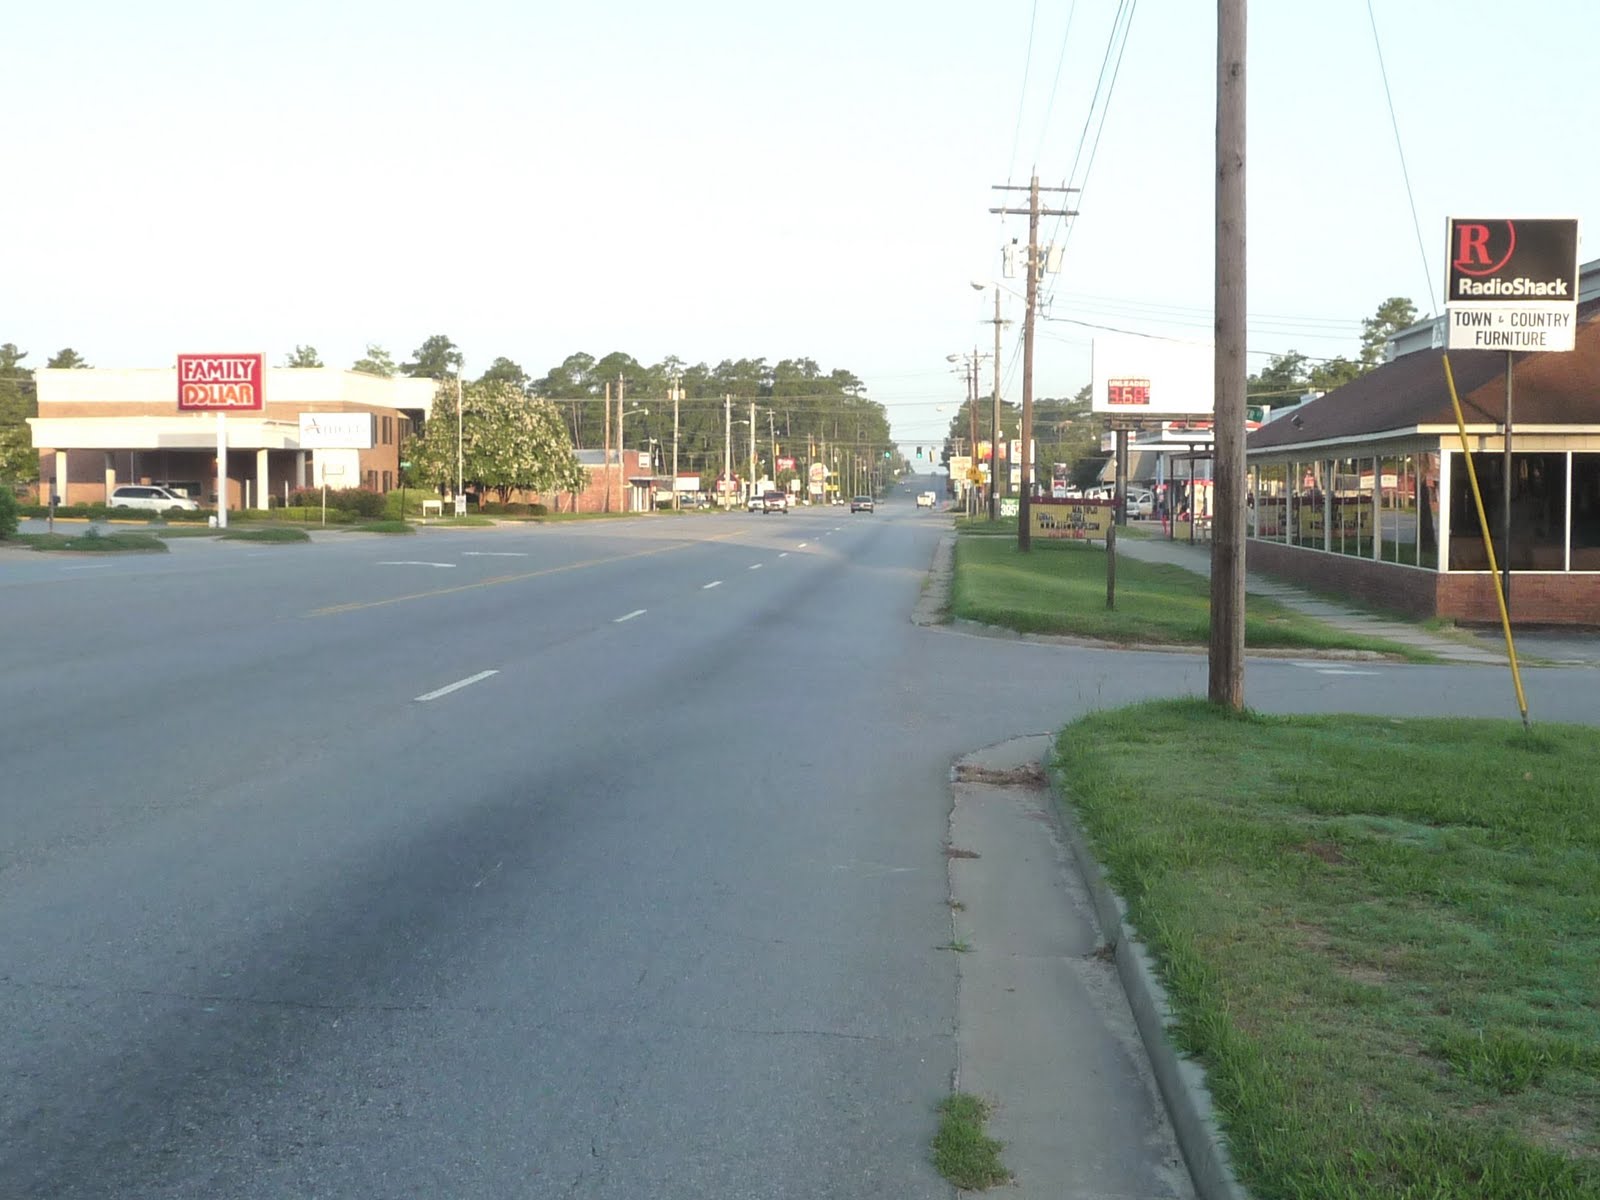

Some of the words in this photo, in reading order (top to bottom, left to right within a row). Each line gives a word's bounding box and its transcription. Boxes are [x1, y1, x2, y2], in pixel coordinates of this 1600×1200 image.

[1458, 278, 1568, 296] RadioShack
[1454, 311, 1492, 326] TOWN
[1510, 312, 1570, 327] COUNTRY
[1475, 330, 1548, 346] FURNITURE
[181, 359, 256, 382] FAMILY
[181, 383, 255, 406] DOLLAR
